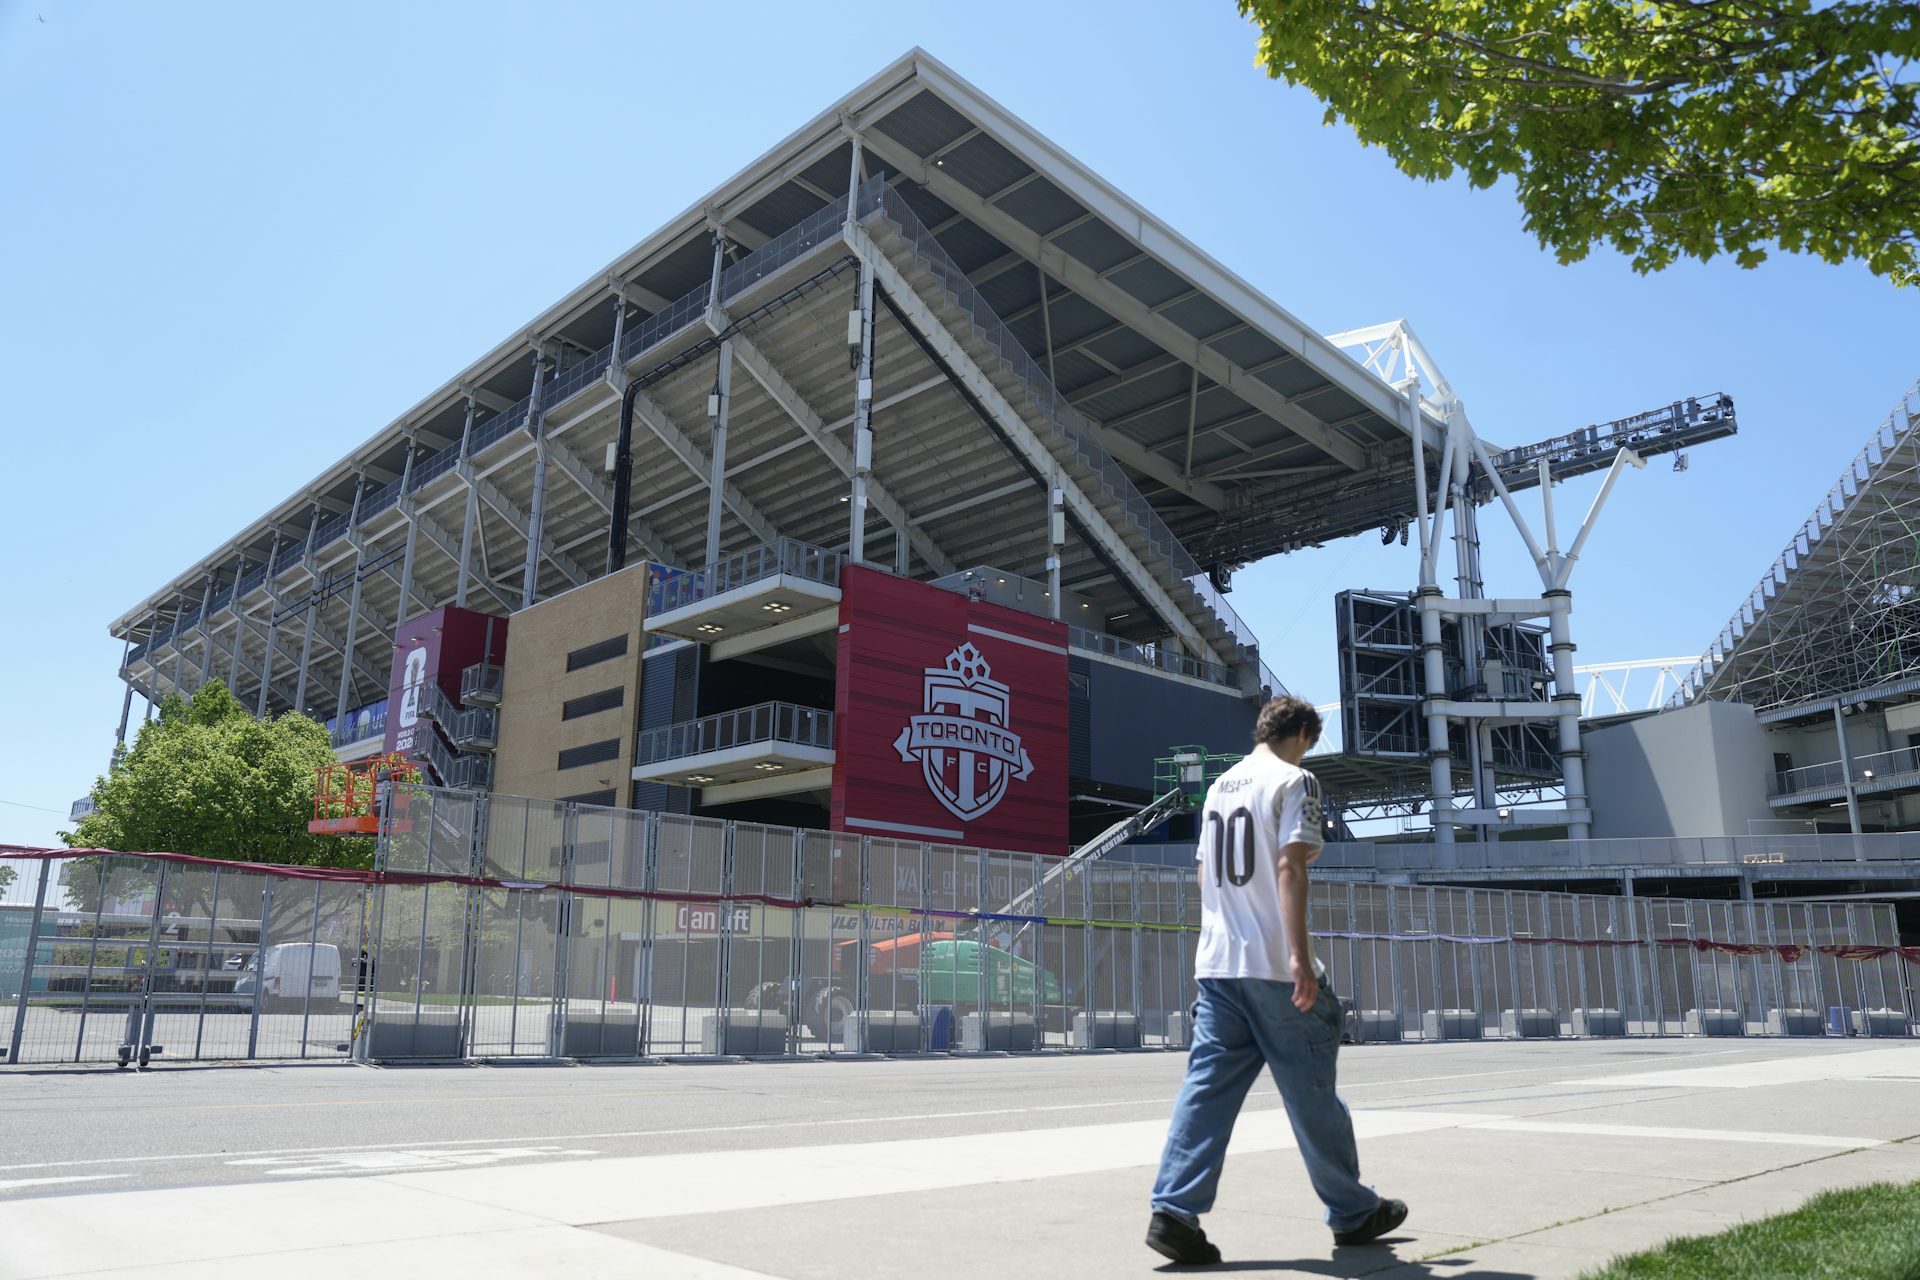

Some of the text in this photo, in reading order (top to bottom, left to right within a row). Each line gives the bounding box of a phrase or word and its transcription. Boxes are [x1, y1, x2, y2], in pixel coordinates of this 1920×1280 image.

[396, 737, 417, 752] 202
[916, 720, 1016, 757] TORONTO
[1072, 829, 1129, 875] SUBELT RENTALS
[1208, 806, 1255, 888] 10
[896, 865, 938, 895] WA
[963, 870, 1029, 900] HNOR
[830, 915, 859, 931] JLG
